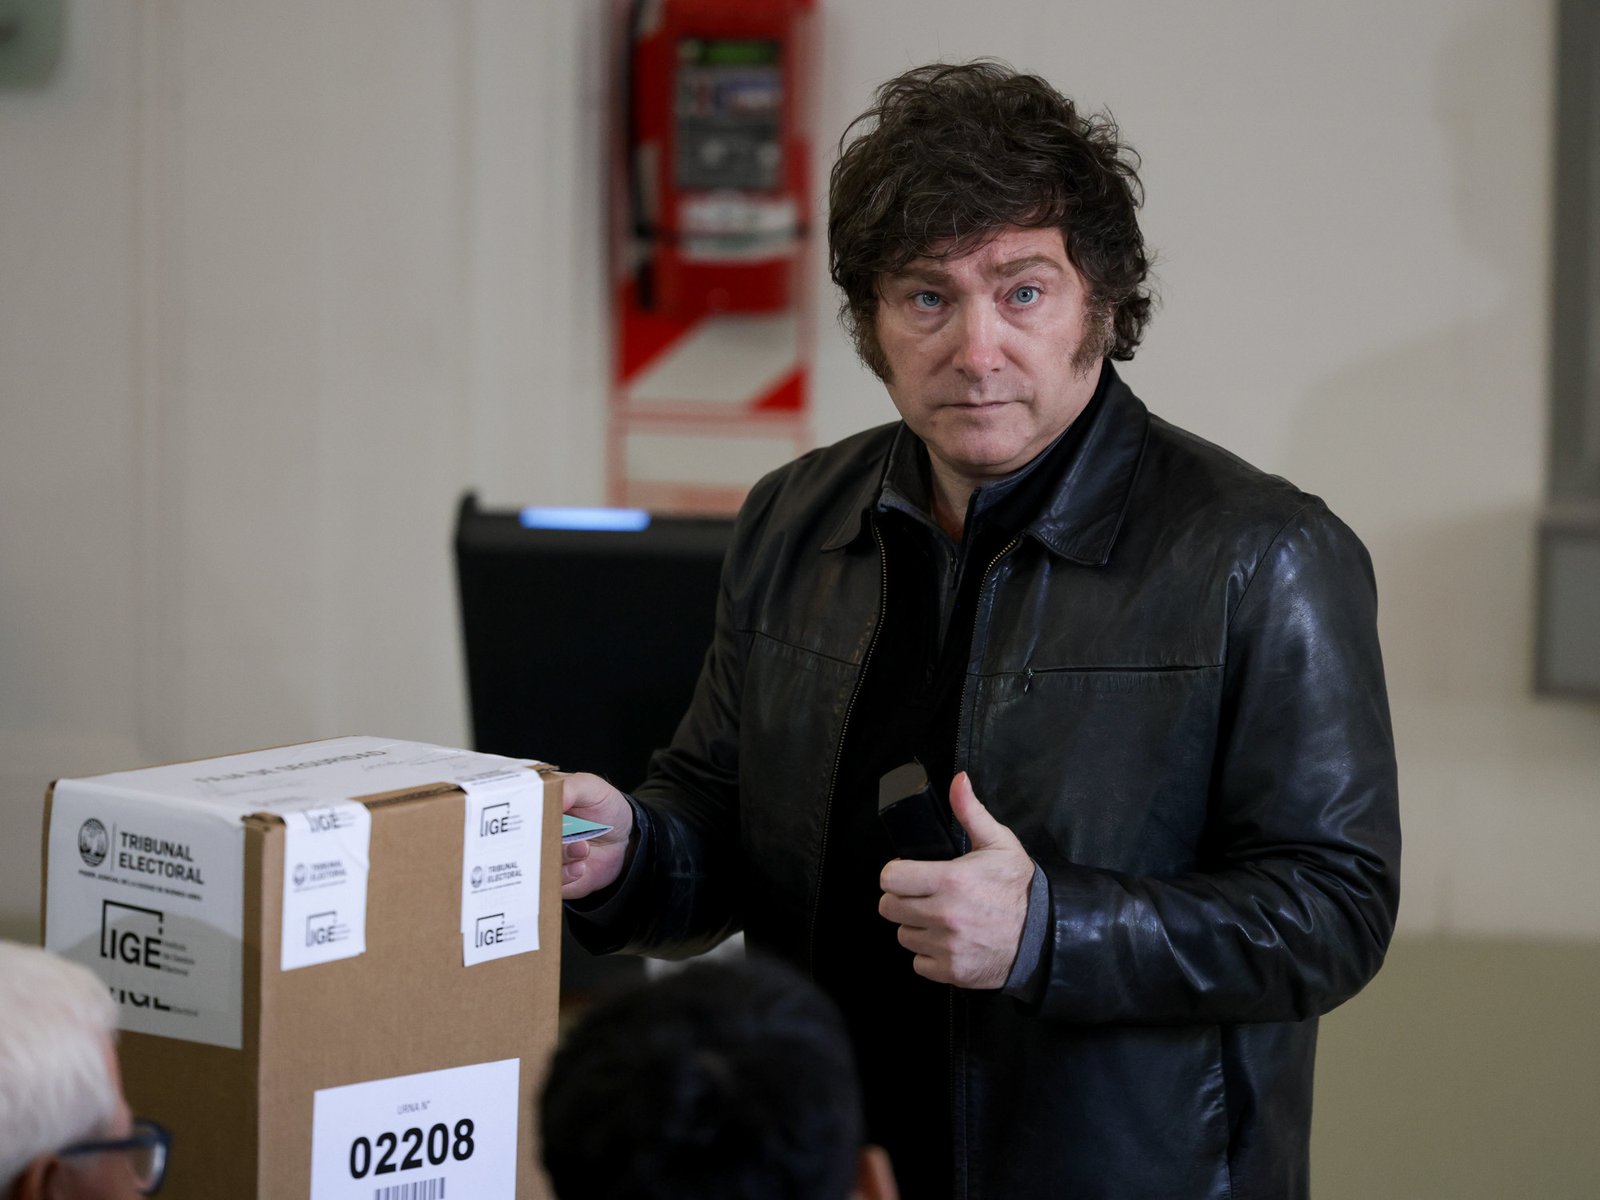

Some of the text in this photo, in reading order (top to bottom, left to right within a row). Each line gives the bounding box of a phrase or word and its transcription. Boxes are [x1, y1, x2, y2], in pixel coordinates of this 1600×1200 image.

[485, 816, 509, 837] IGE
[120, 831, 194, 862] TRIBUNAL
[118, 852, 204, 884] ELECTORAL
[110, 929, 162, 970] IGE
[480, 927, 504, 947] IGE
[350, 1118, 475, 1179] 02208
